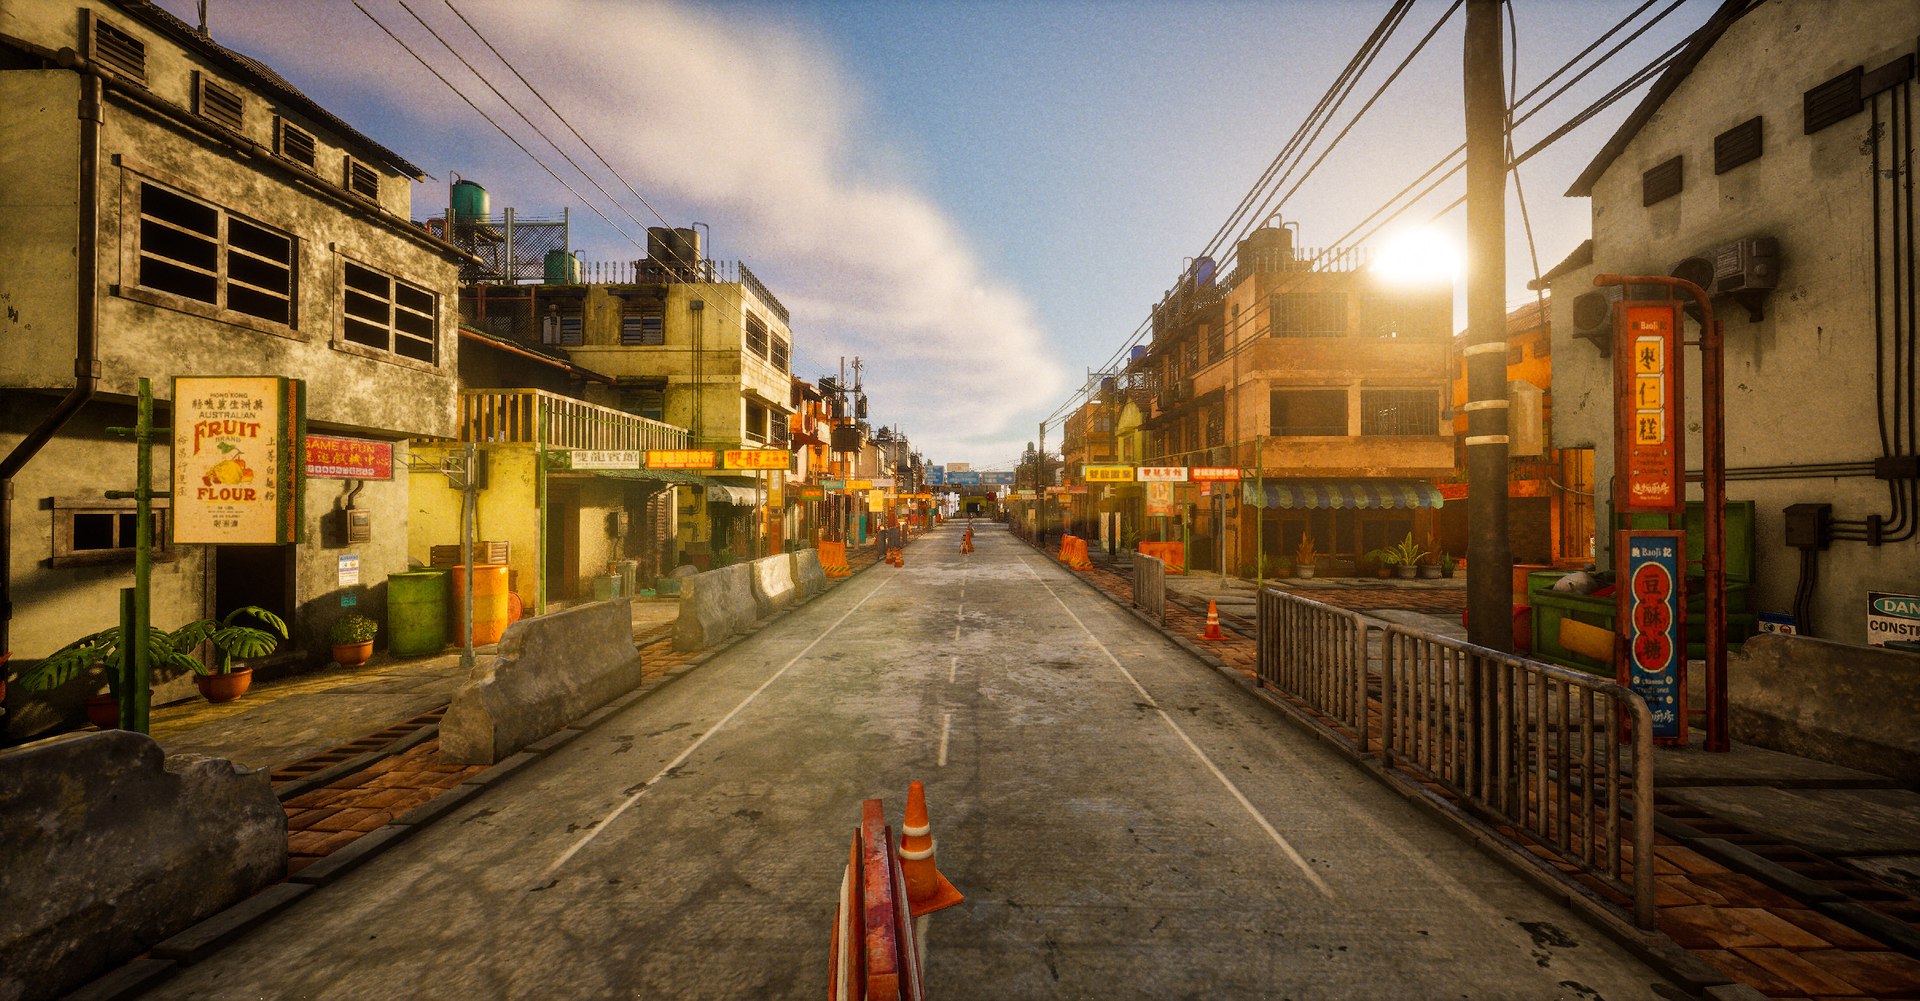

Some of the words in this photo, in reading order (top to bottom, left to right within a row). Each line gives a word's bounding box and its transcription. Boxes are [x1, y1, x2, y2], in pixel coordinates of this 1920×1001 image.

[199, 411, 256, 419] AUSTRALIAN
[193, 420, 261, 455] FRUIT
[350, 443, 375, 453] FUN
[196, 487, 256, 501] FLOUR
